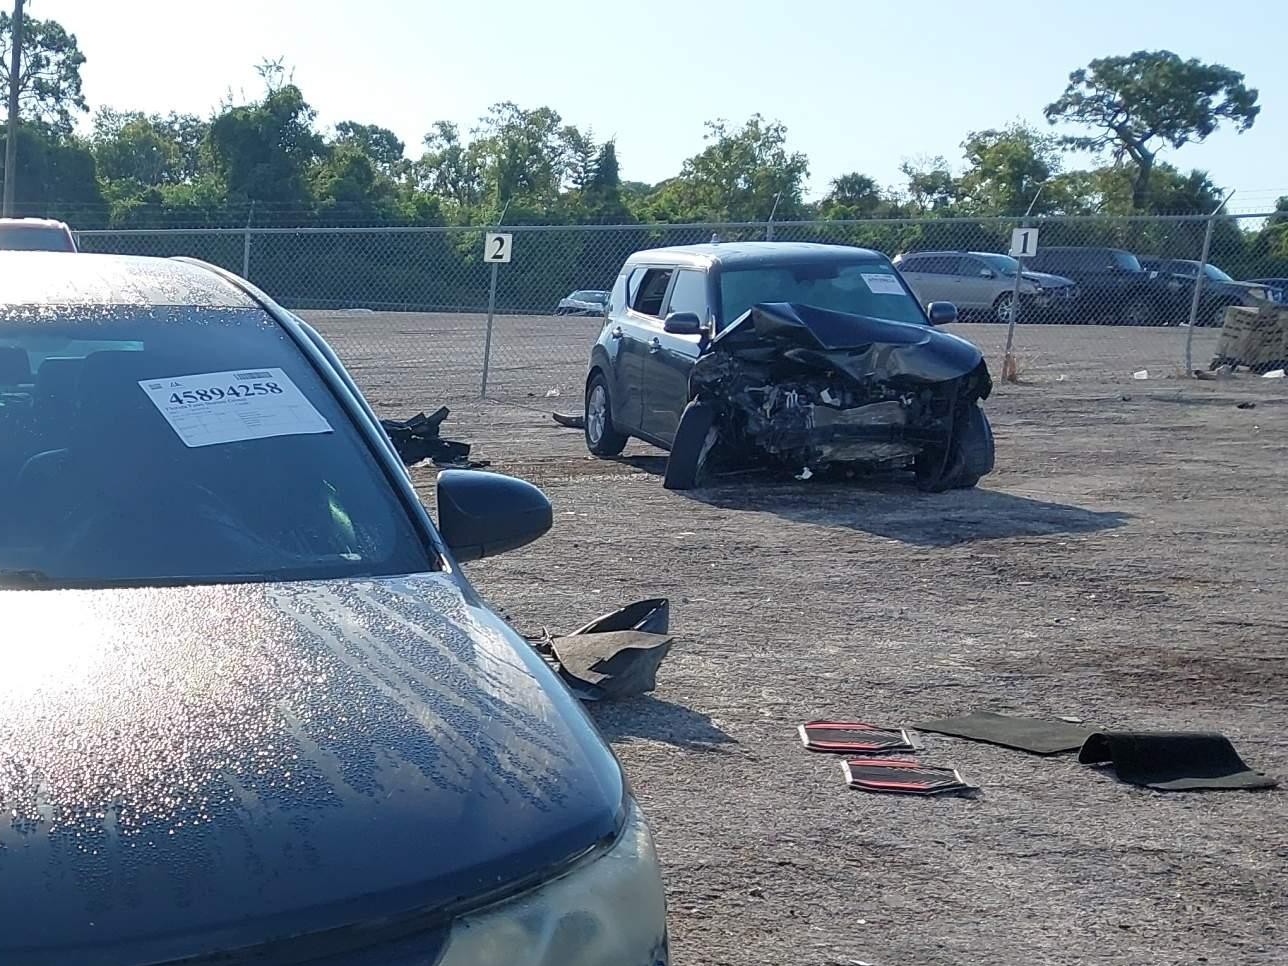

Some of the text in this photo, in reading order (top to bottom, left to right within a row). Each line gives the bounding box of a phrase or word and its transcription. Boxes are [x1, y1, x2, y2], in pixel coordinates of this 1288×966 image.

[491, 236, 505, 259] 2
[1021, 231, 1029, 253] 1
[169, 382, 283, 405] 45894258
